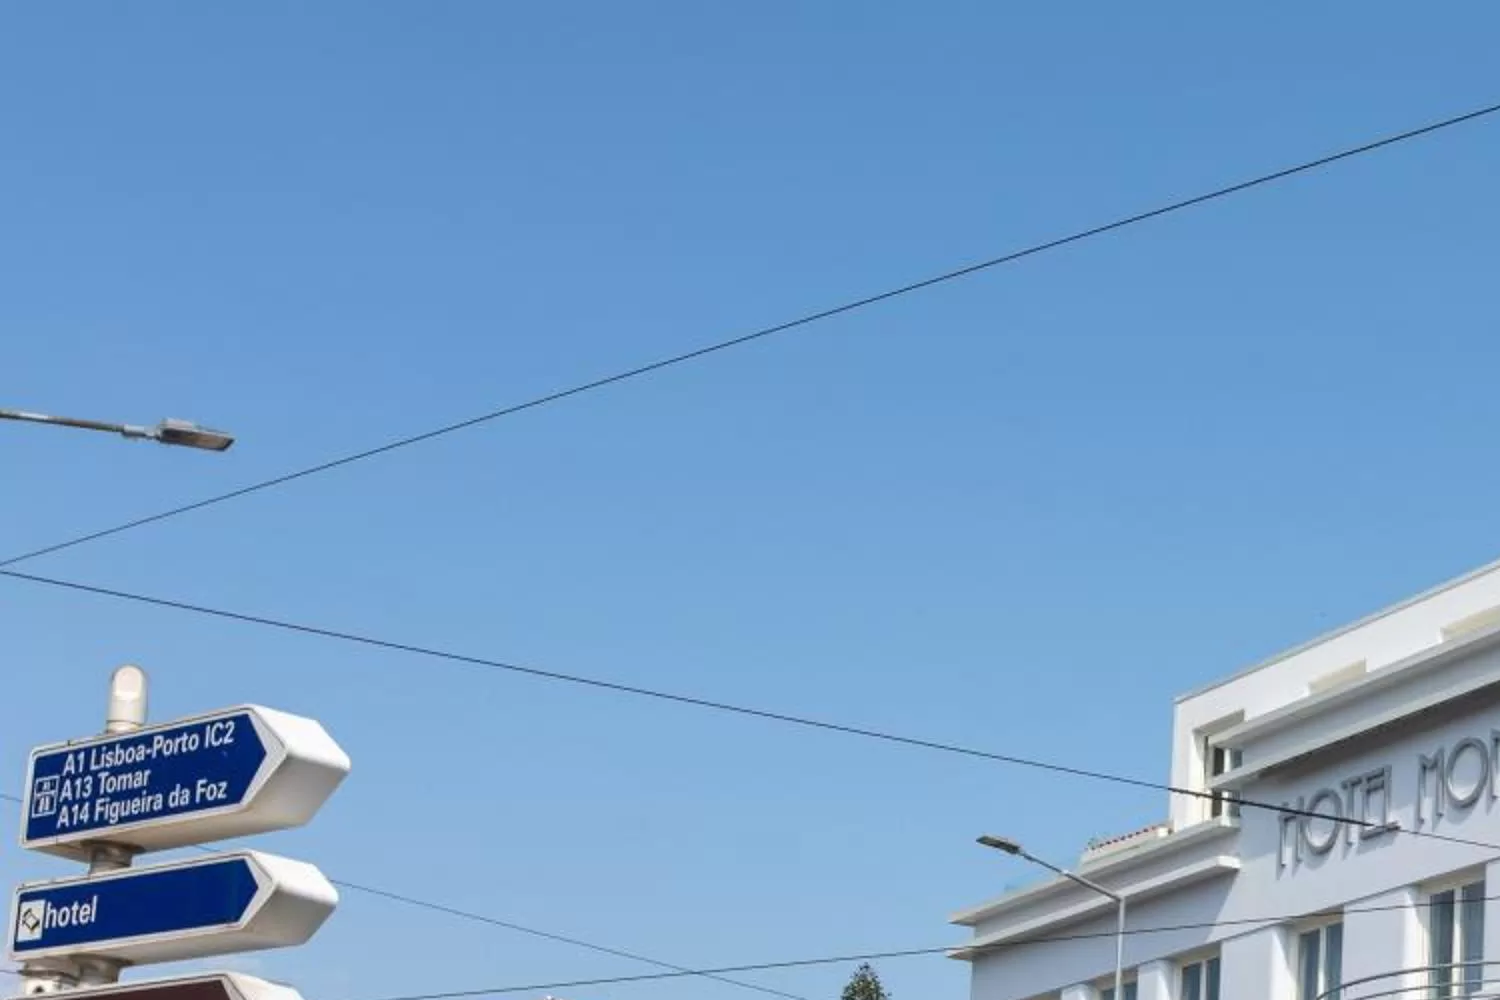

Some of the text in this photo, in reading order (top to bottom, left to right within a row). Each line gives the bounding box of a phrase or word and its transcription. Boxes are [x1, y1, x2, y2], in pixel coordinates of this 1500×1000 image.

[63, 721, 235, 776] A1 Lisboa-Porto IC2
[56, 779, 227, 829] A14 Figueira da Foz
[59, 768, 151, 801] A13 Tomar
[1278, 764, 1400, 869] HOTEL
[45, 896, 97, 928] hotel
